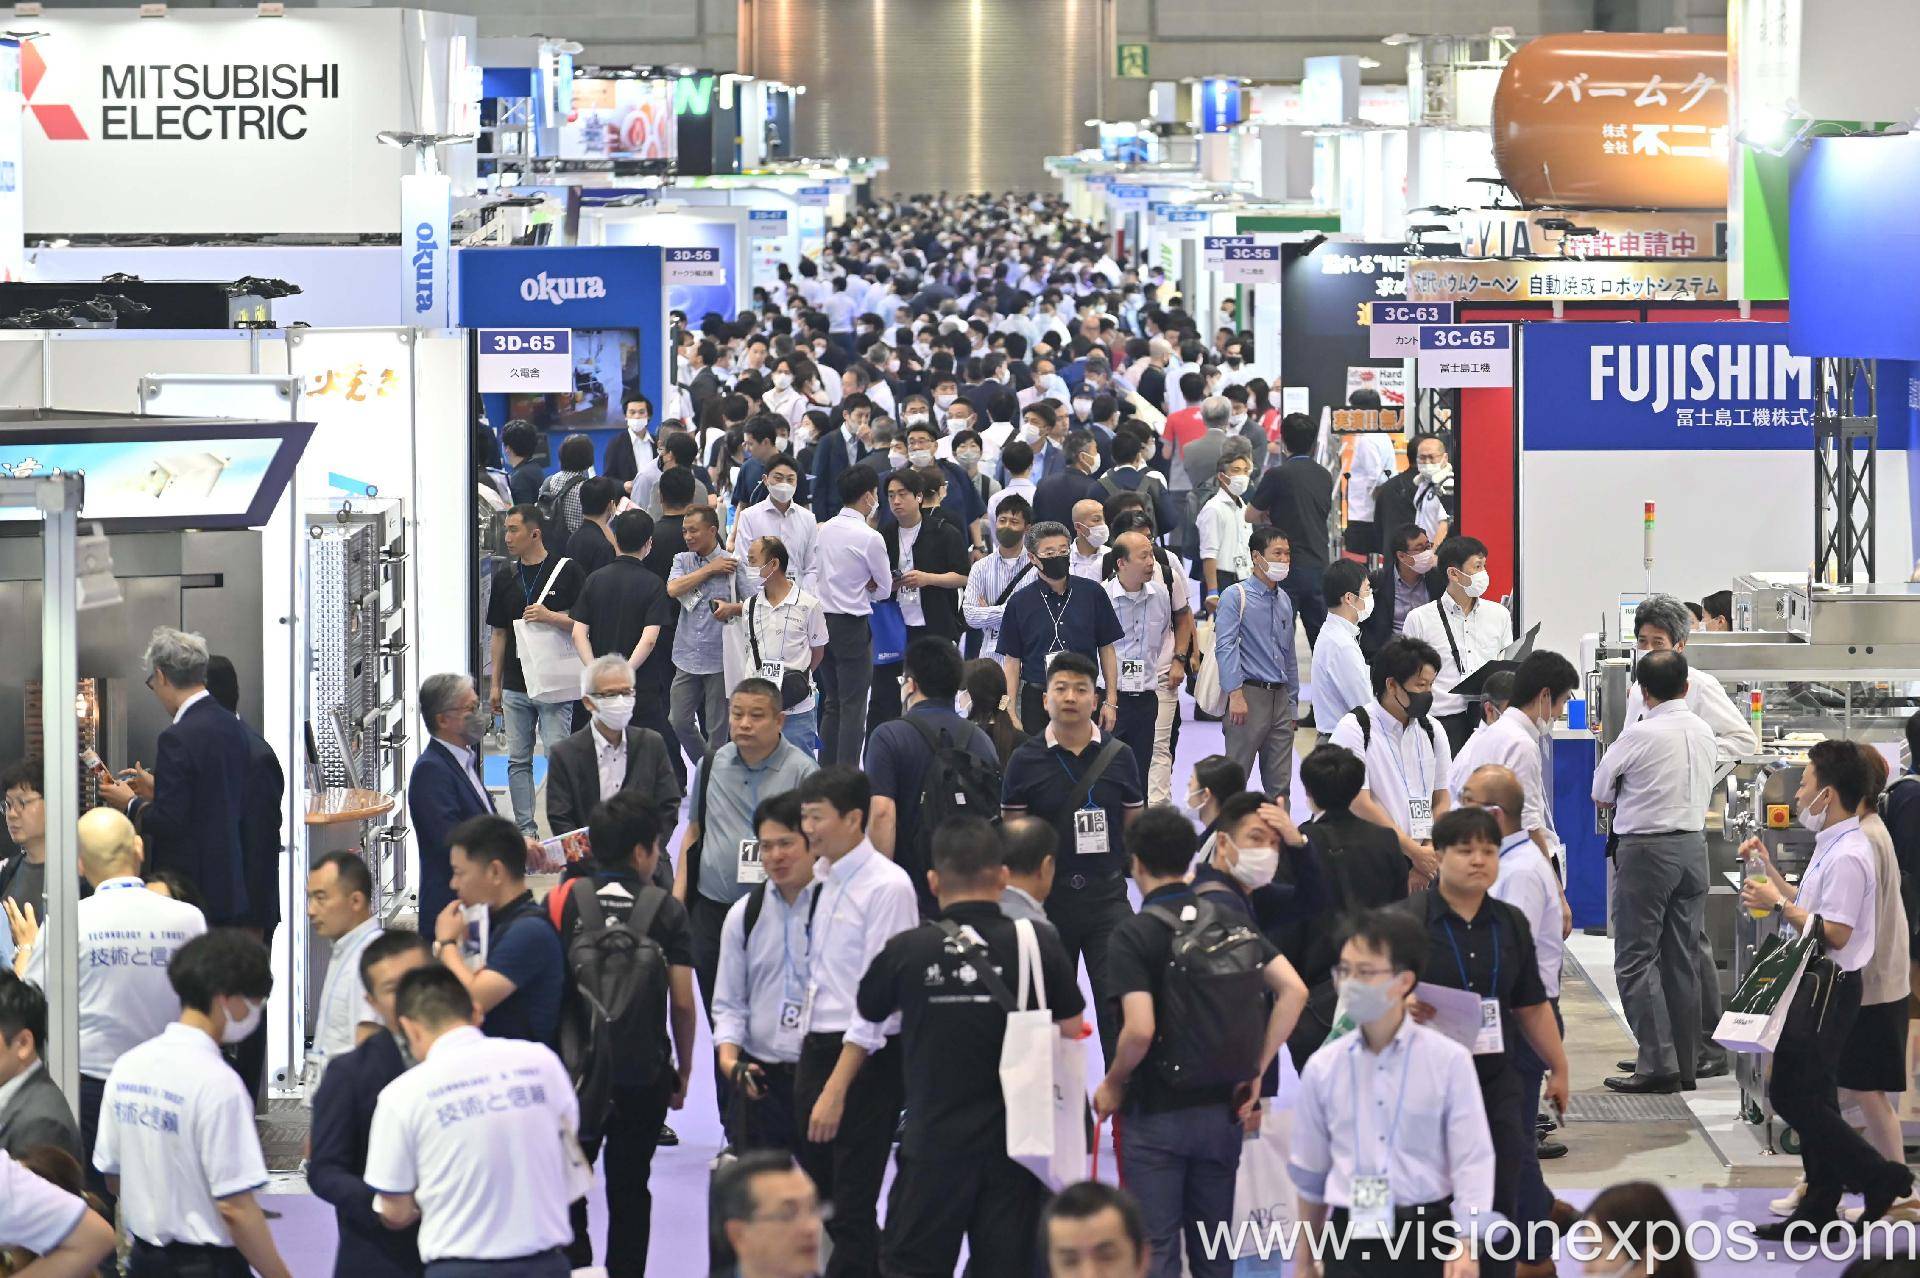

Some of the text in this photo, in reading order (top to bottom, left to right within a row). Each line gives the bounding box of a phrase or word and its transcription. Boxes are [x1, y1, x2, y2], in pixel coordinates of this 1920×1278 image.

[102, 64, 338, 98] MITSUBISHI
[102, 104, 307, 140] ELECTRIC
[673, 250, 712, 261] 3D-56
[1232, 248, 1271, 259] 3C-56
[411, 222, 438, 314] okura
[520, 272, 606, 304] okura
[1384, 307, 1439, 321] 3C-63
[493, 335, 556, 351] 3D-65
[1434, 330, 1496, 346] 3C-65
[1676, 408, 1837, 427] 冨士島工機株式
[1411, 803, 1423, 818] 18
[89, 946, 178, 968] 技術と信
